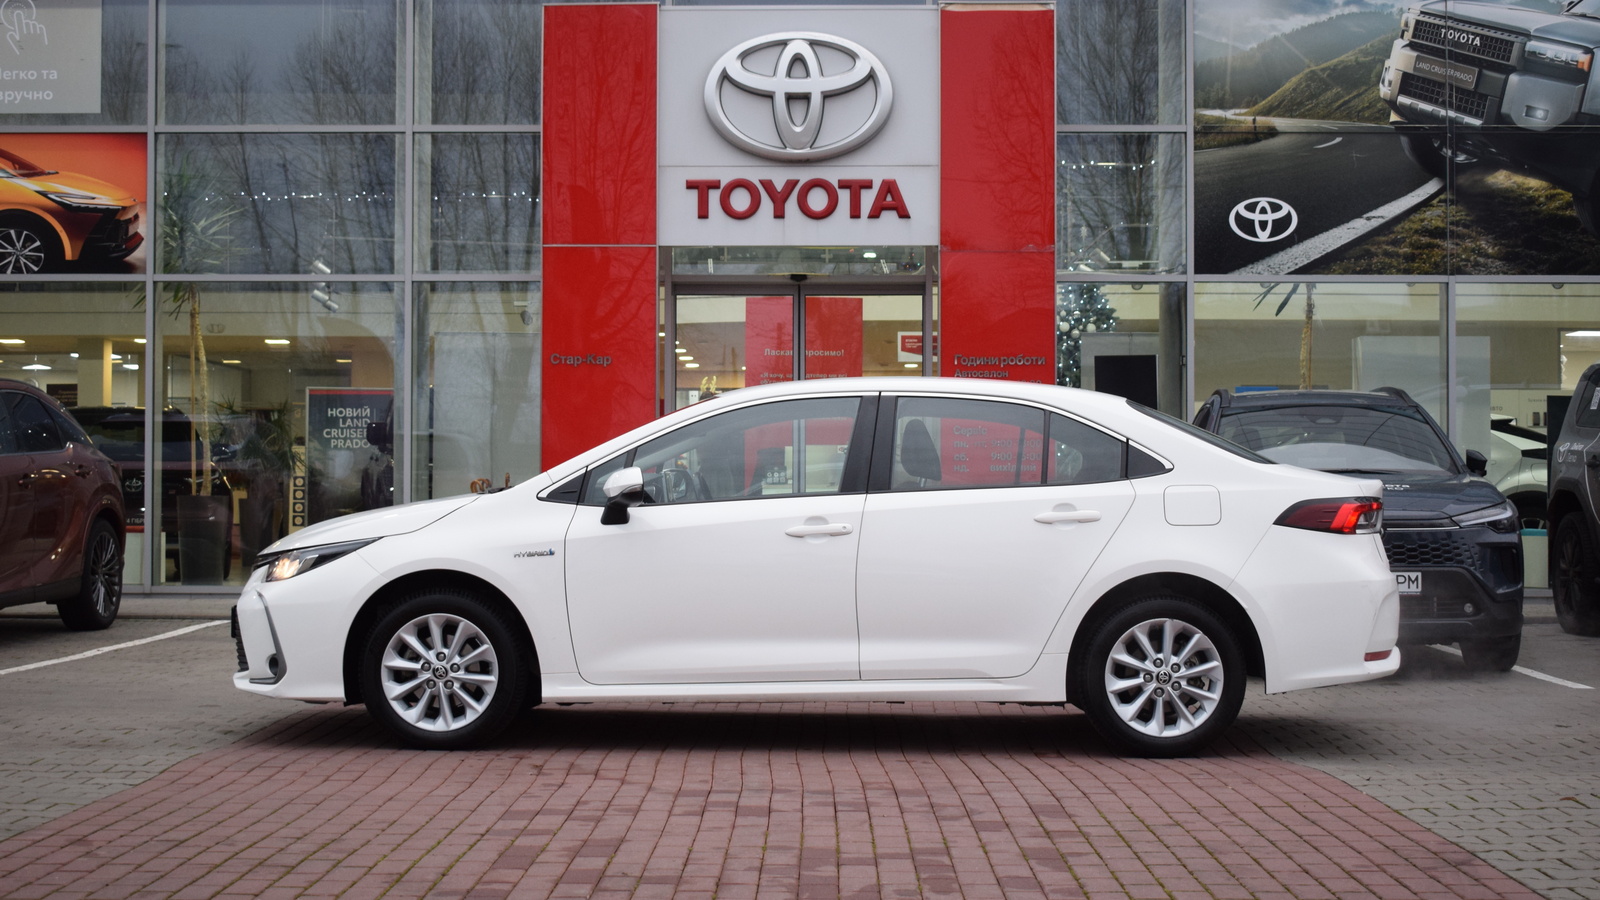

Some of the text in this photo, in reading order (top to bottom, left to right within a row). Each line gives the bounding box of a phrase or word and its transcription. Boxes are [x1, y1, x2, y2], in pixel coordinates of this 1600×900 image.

[1441, 28, 1481, 46] TOYOTA
[0, 67, 58, 80] егко та
[1416, 61, 1473, 82] LAND CRUISER PRADO
[686, 178, 911, 220] TOYOTA
[764, 348, 793, 356] Ласка
[550, 353, 612, 367] Стар-Кар
[954, 354, 1045, 367] Години роботи
[954, 369, 1008, 377] Автосалон
[327, 406, 371, 417] НОВИЙ
[340, 418, 371, 427] LAND
[953, 426, 988, 437] Сервіс
[331, 439, 371, 448] PRADO
[992, 439, 1012, 447] 9:00
[991, 452, 1012, 460] 9:00
